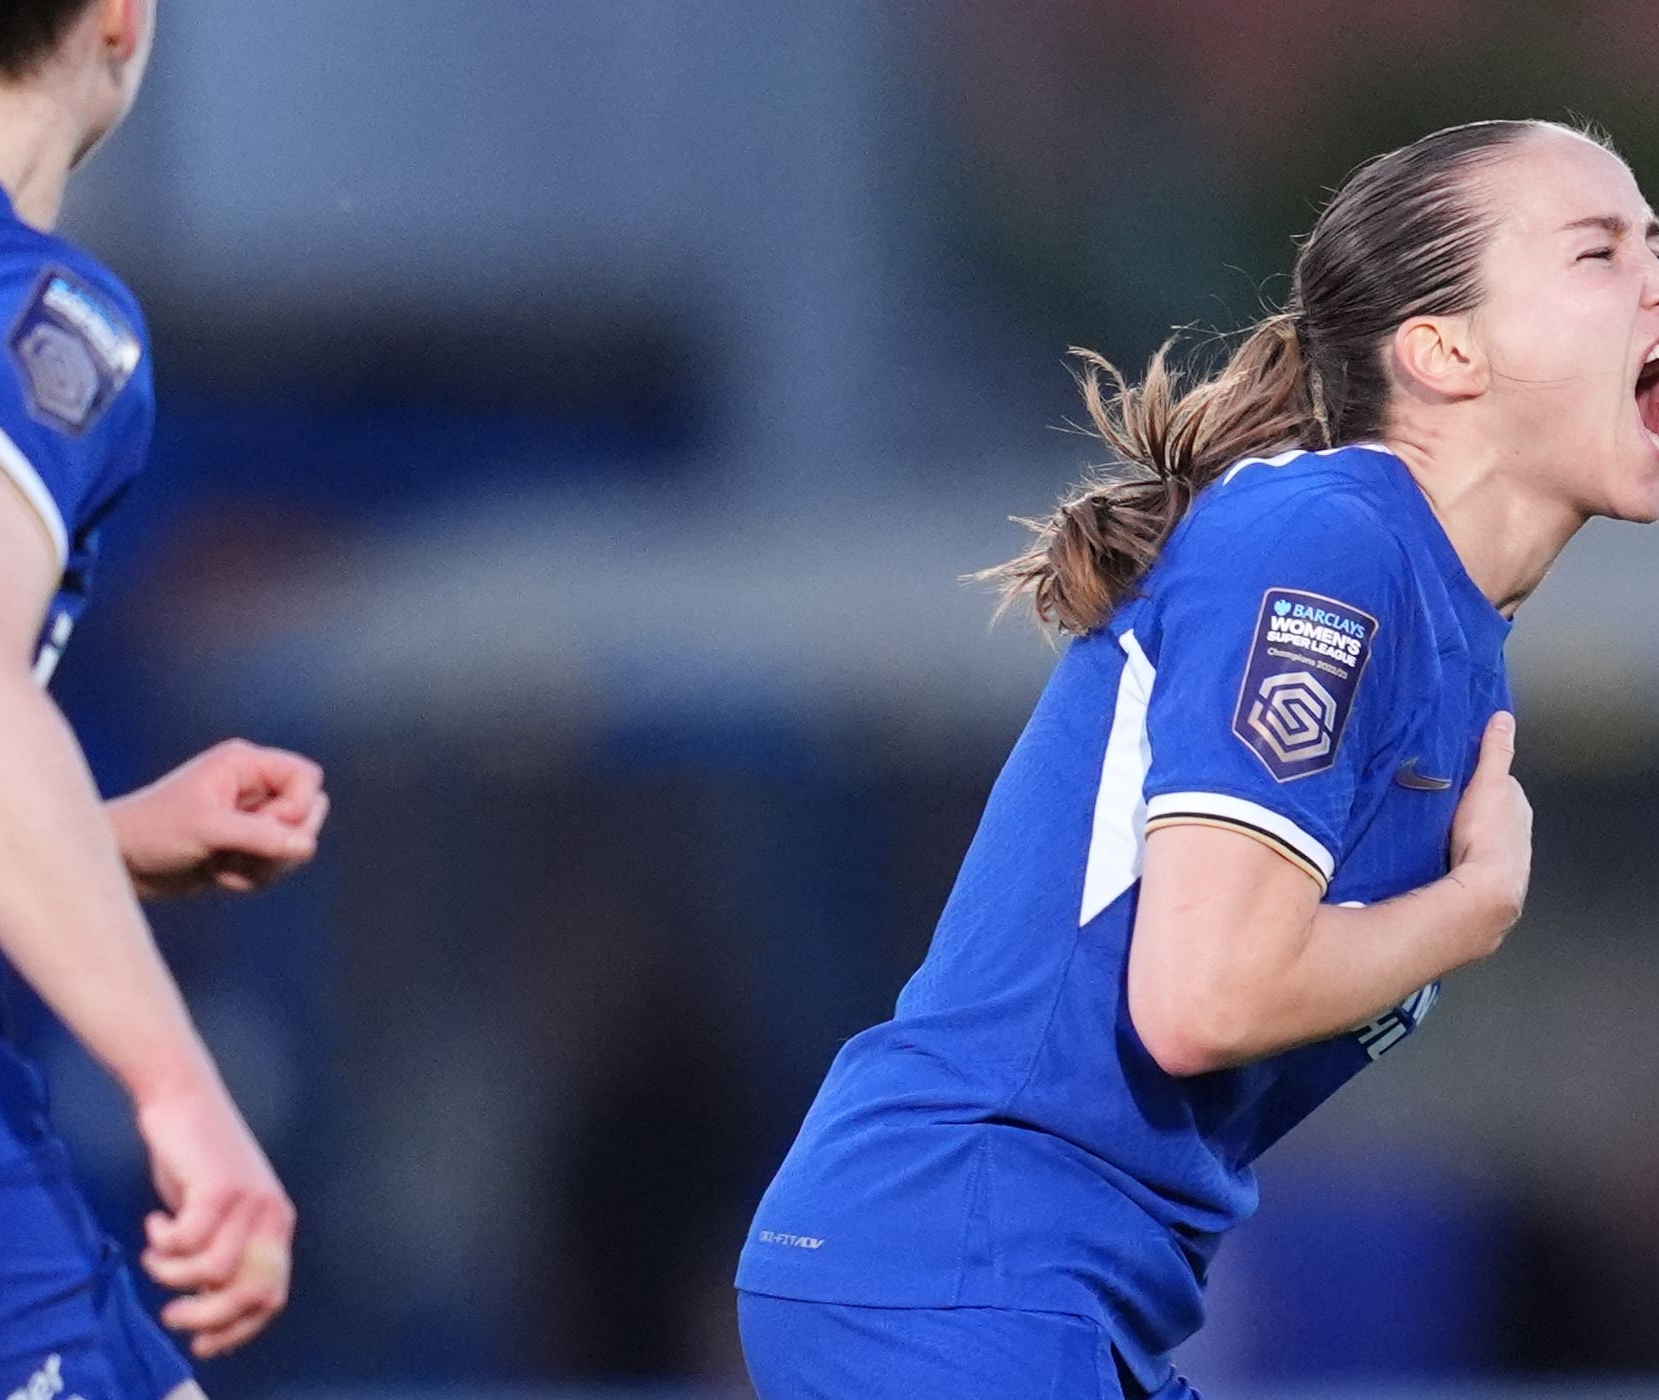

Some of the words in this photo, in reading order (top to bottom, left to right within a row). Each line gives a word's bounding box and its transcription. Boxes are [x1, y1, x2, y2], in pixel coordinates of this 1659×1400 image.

[1270, 615, 1362, 657] WOMEN'S
[1292, 603, 1366, 640] BARCLAYS
[1266, 630, 1312, 650] SUPER
[1310, 638, 1358, 668] LEAGUE
